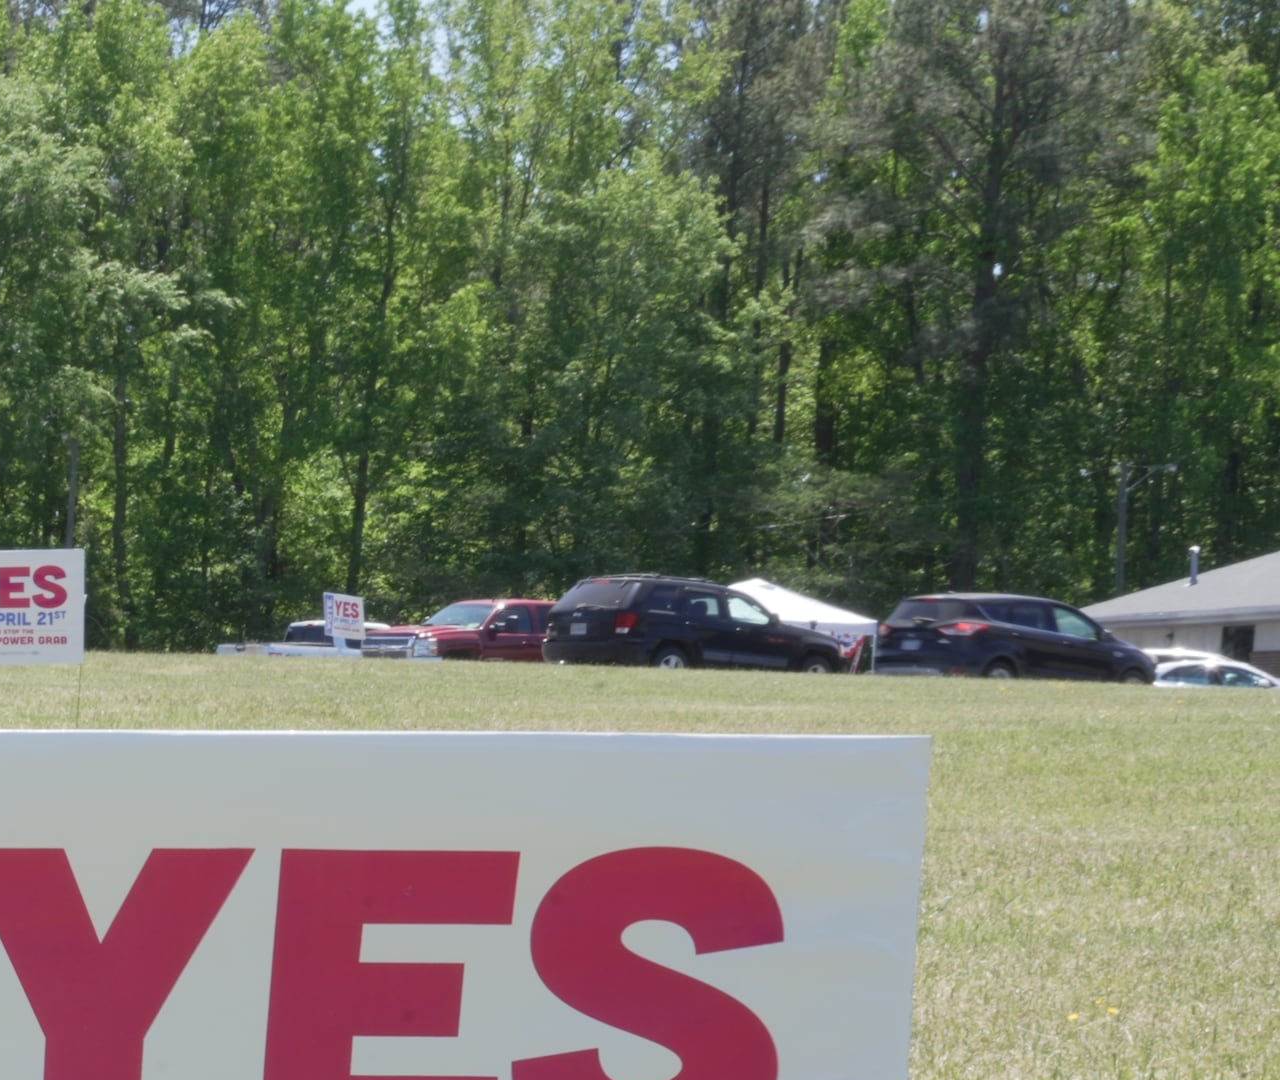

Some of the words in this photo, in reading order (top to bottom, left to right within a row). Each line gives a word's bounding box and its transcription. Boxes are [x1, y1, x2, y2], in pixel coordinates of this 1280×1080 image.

[335, 600, 359, 618] YES
[37, 610, 67, 626] 21ST
[38, 636, 68, 645] GRAB
